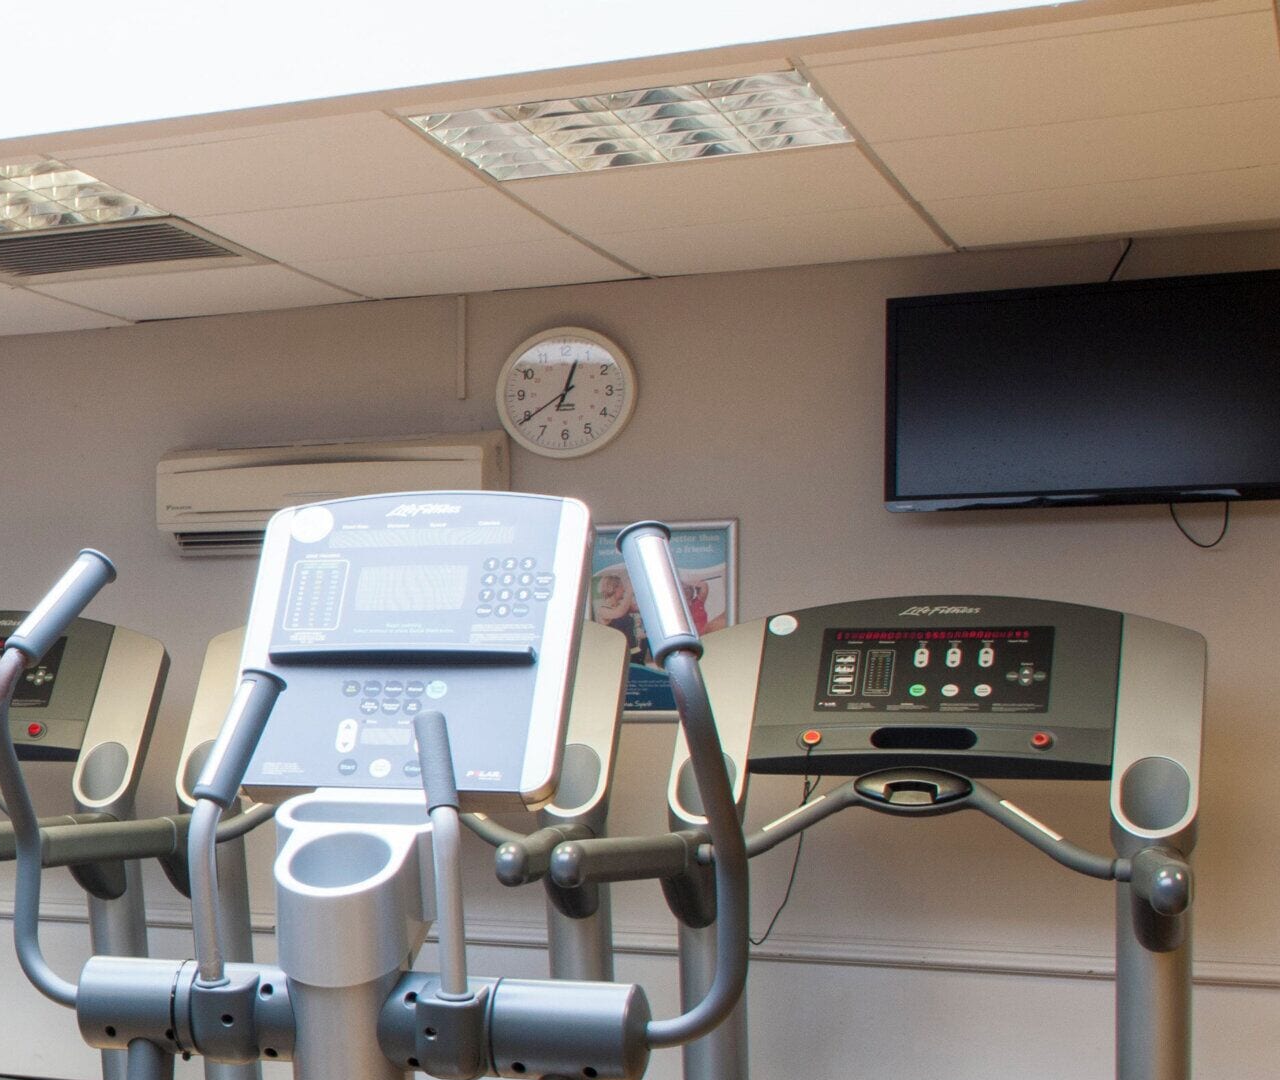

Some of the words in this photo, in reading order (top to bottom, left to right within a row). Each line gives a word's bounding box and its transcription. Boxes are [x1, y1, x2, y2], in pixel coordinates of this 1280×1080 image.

[560, 345, 572, 357] 12
[523, 368, 535, 380] 10
[600, 364, 609, 376] 2
[517, 389, 525, 401] 9
[605, 385, 614, 396] 3
[599, 406, 608, 417] 4
[538, 425, 547, 436] 7
[583, 423, 592, 434] 5
[561, 429, 569, 440] 6
[489, 560, 495, 568] 1
[506, 560, 513, 568] 2
[524, 560, 531, 568] 3
[484, 576, 492, 584] 4
[503, 576, 511, 584] 5
[483, 591, 490, 599] 7
[501, 591, 508, 599] 8
[520, 591, 527, 599] 9
[499, 607, 506, 615] 0
[899, 606, 930, 616] Life
[928, 606, 981, 615] Fitness
